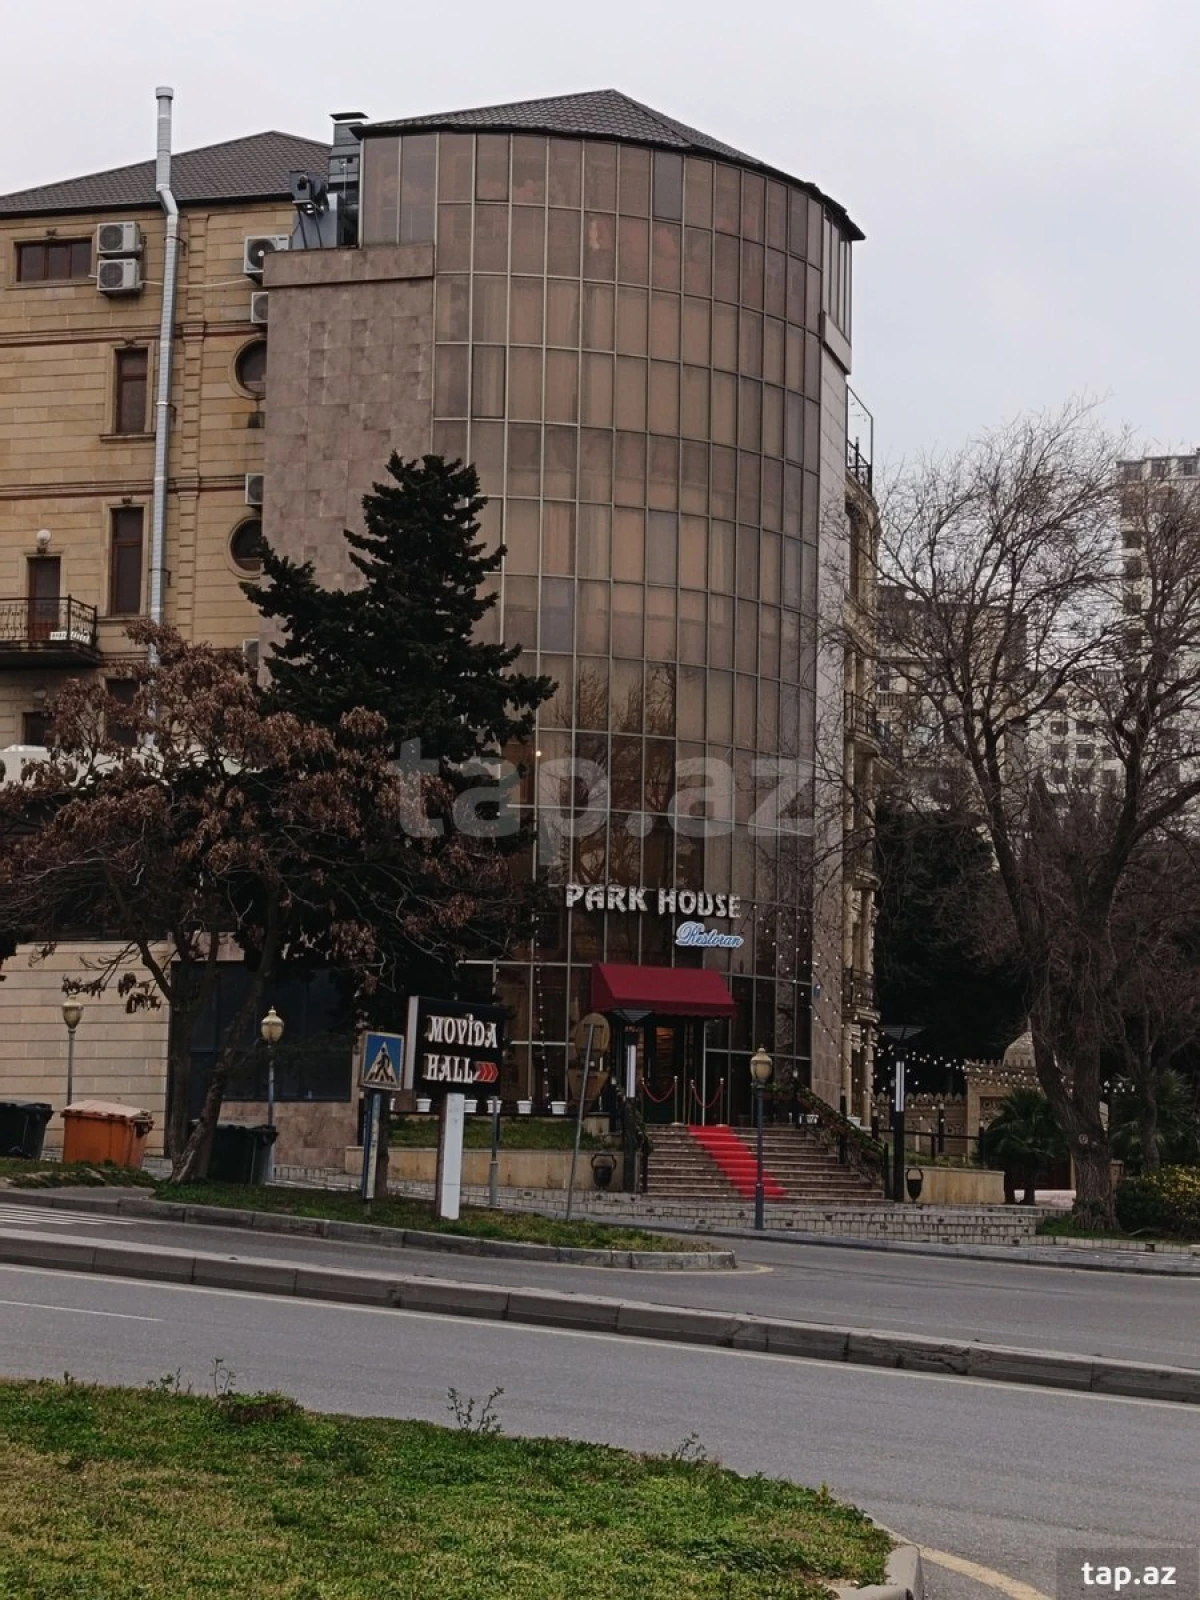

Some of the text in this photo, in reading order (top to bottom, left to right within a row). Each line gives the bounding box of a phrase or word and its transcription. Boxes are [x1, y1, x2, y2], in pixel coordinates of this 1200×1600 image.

[566, 884, 741, 917] PARK HOUSE
[423, 1054, 474, 1084] HALL
